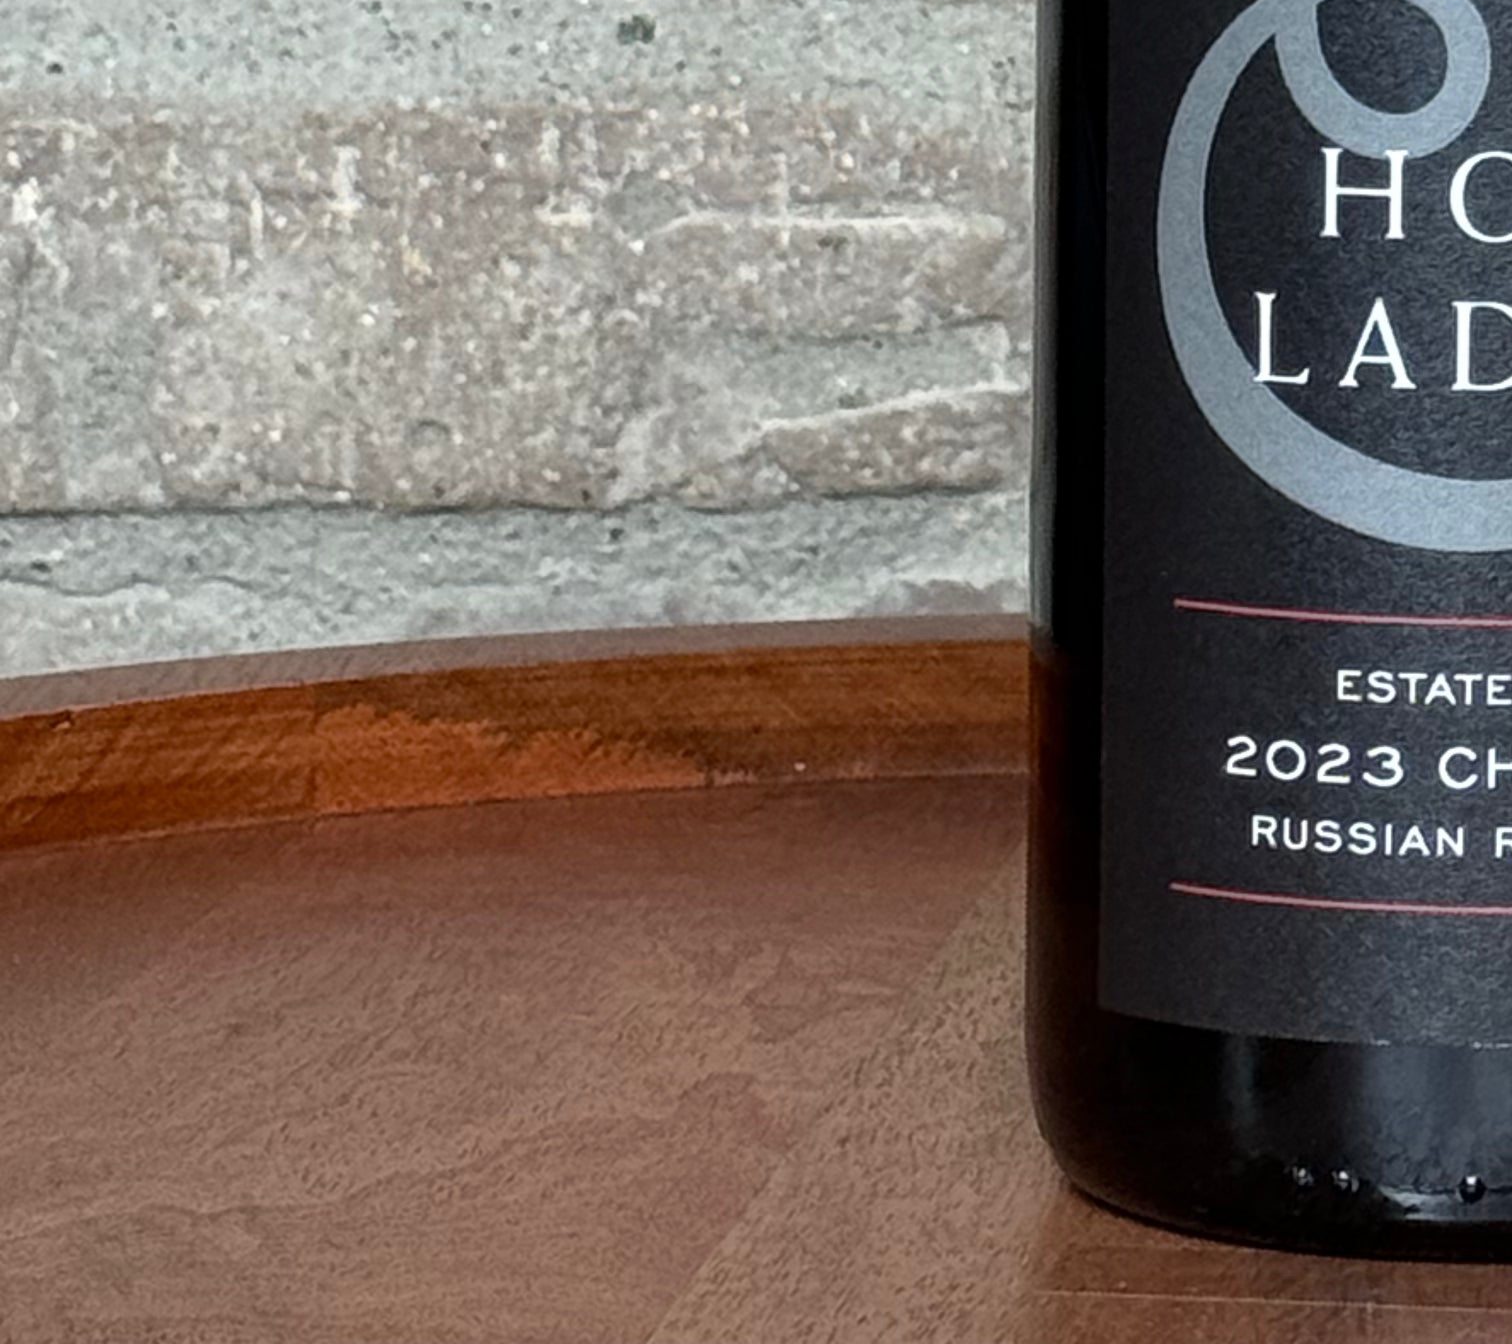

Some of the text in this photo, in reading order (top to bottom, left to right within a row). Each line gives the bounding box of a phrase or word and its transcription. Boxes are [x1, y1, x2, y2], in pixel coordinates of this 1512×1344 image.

[1336, 669, 1512, 706] ESTATE
[1225, 735, 1404, 788] 2023
[1251, 814, 1465, 858] RUSSIAN
